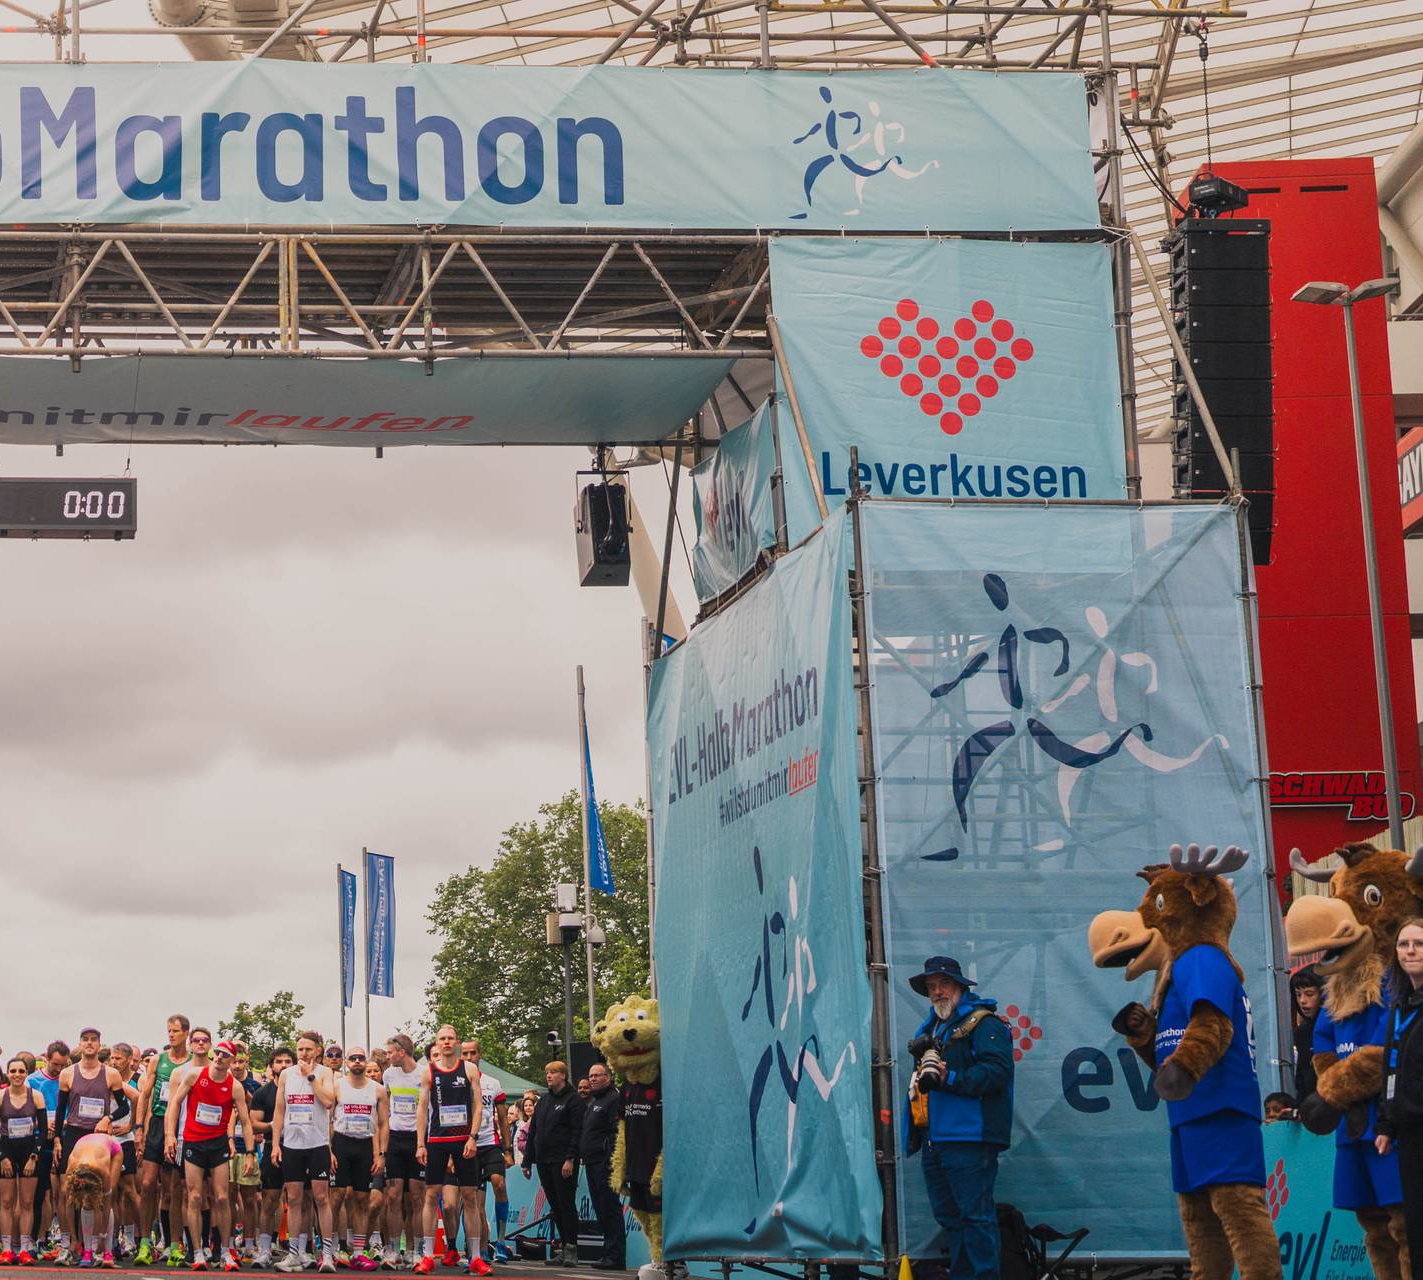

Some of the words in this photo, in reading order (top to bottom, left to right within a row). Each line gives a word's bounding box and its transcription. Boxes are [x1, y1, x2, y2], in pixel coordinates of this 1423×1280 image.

[821, 452, 1088, 498] Leverkusen
[64, 491, 125, 518] 0:00
[669, 666, 819, 804] EVL-HalbMarathon
[1330, 1239, 1367, 1267] Energie
